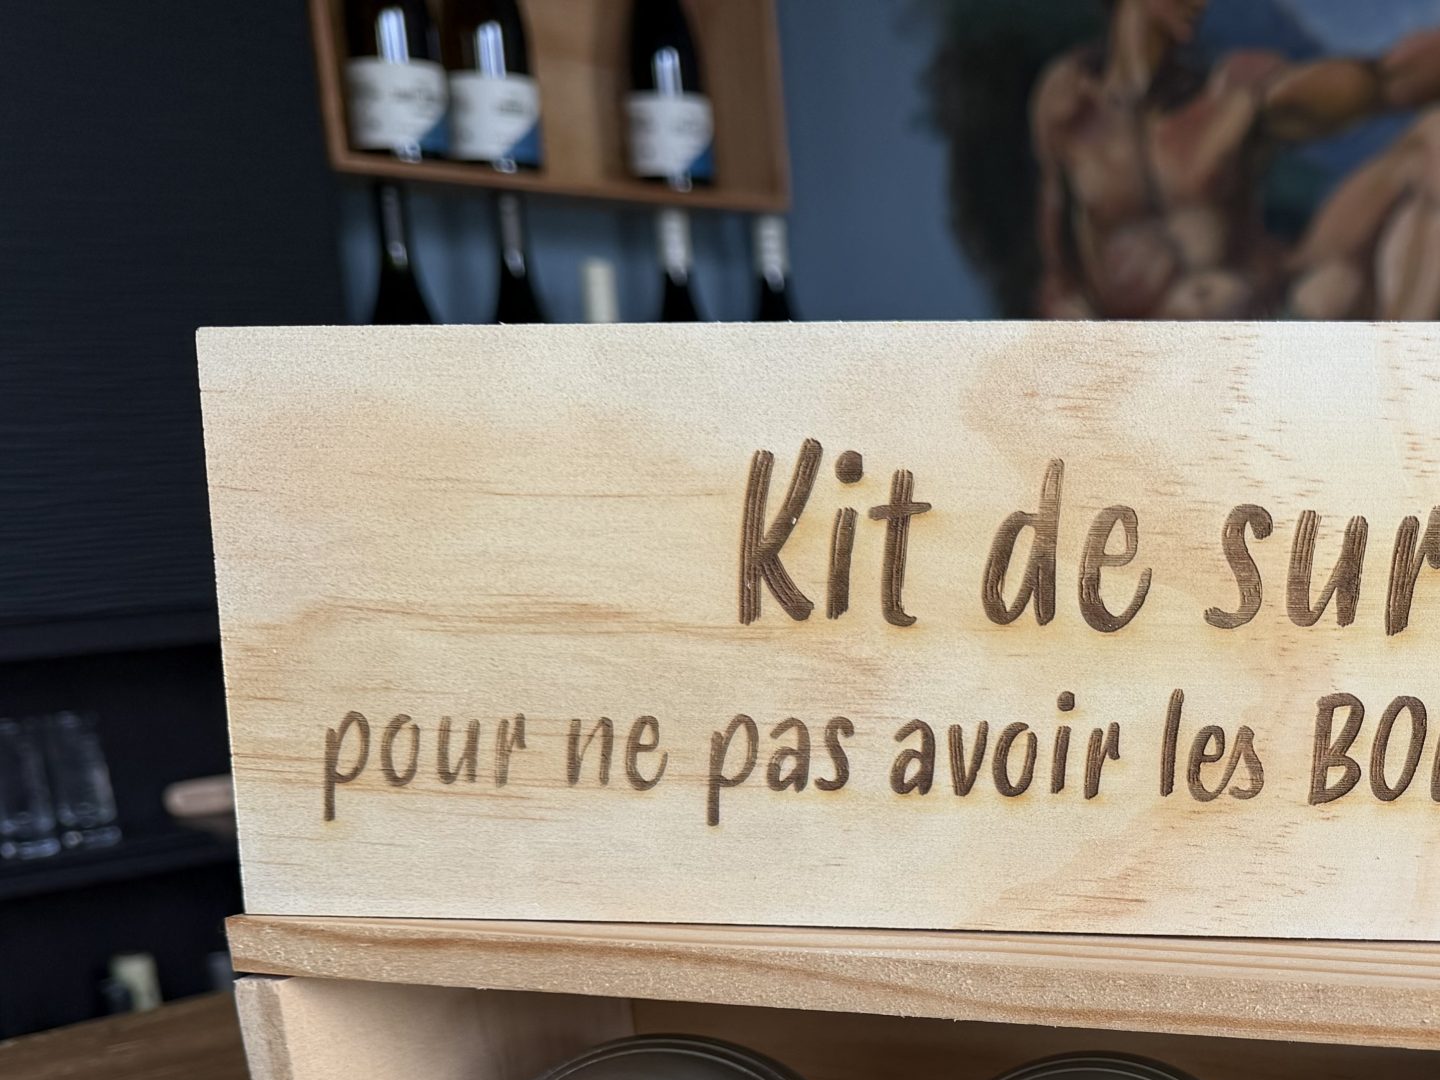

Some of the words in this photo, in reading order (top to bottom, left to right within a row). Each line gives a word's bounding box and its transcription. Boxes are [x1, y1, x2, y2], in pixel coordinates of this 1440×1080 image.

[738, 437, 932, 626] Kit
[981, 458, 1152, 632] de
[324, 710, 527, 821] pour
[567, 714, 669, 791] ne
[707, 713, 855, 827] pas
[889, 691, 1120, 800] avoir
[1160, 688, 1264, 802] les
